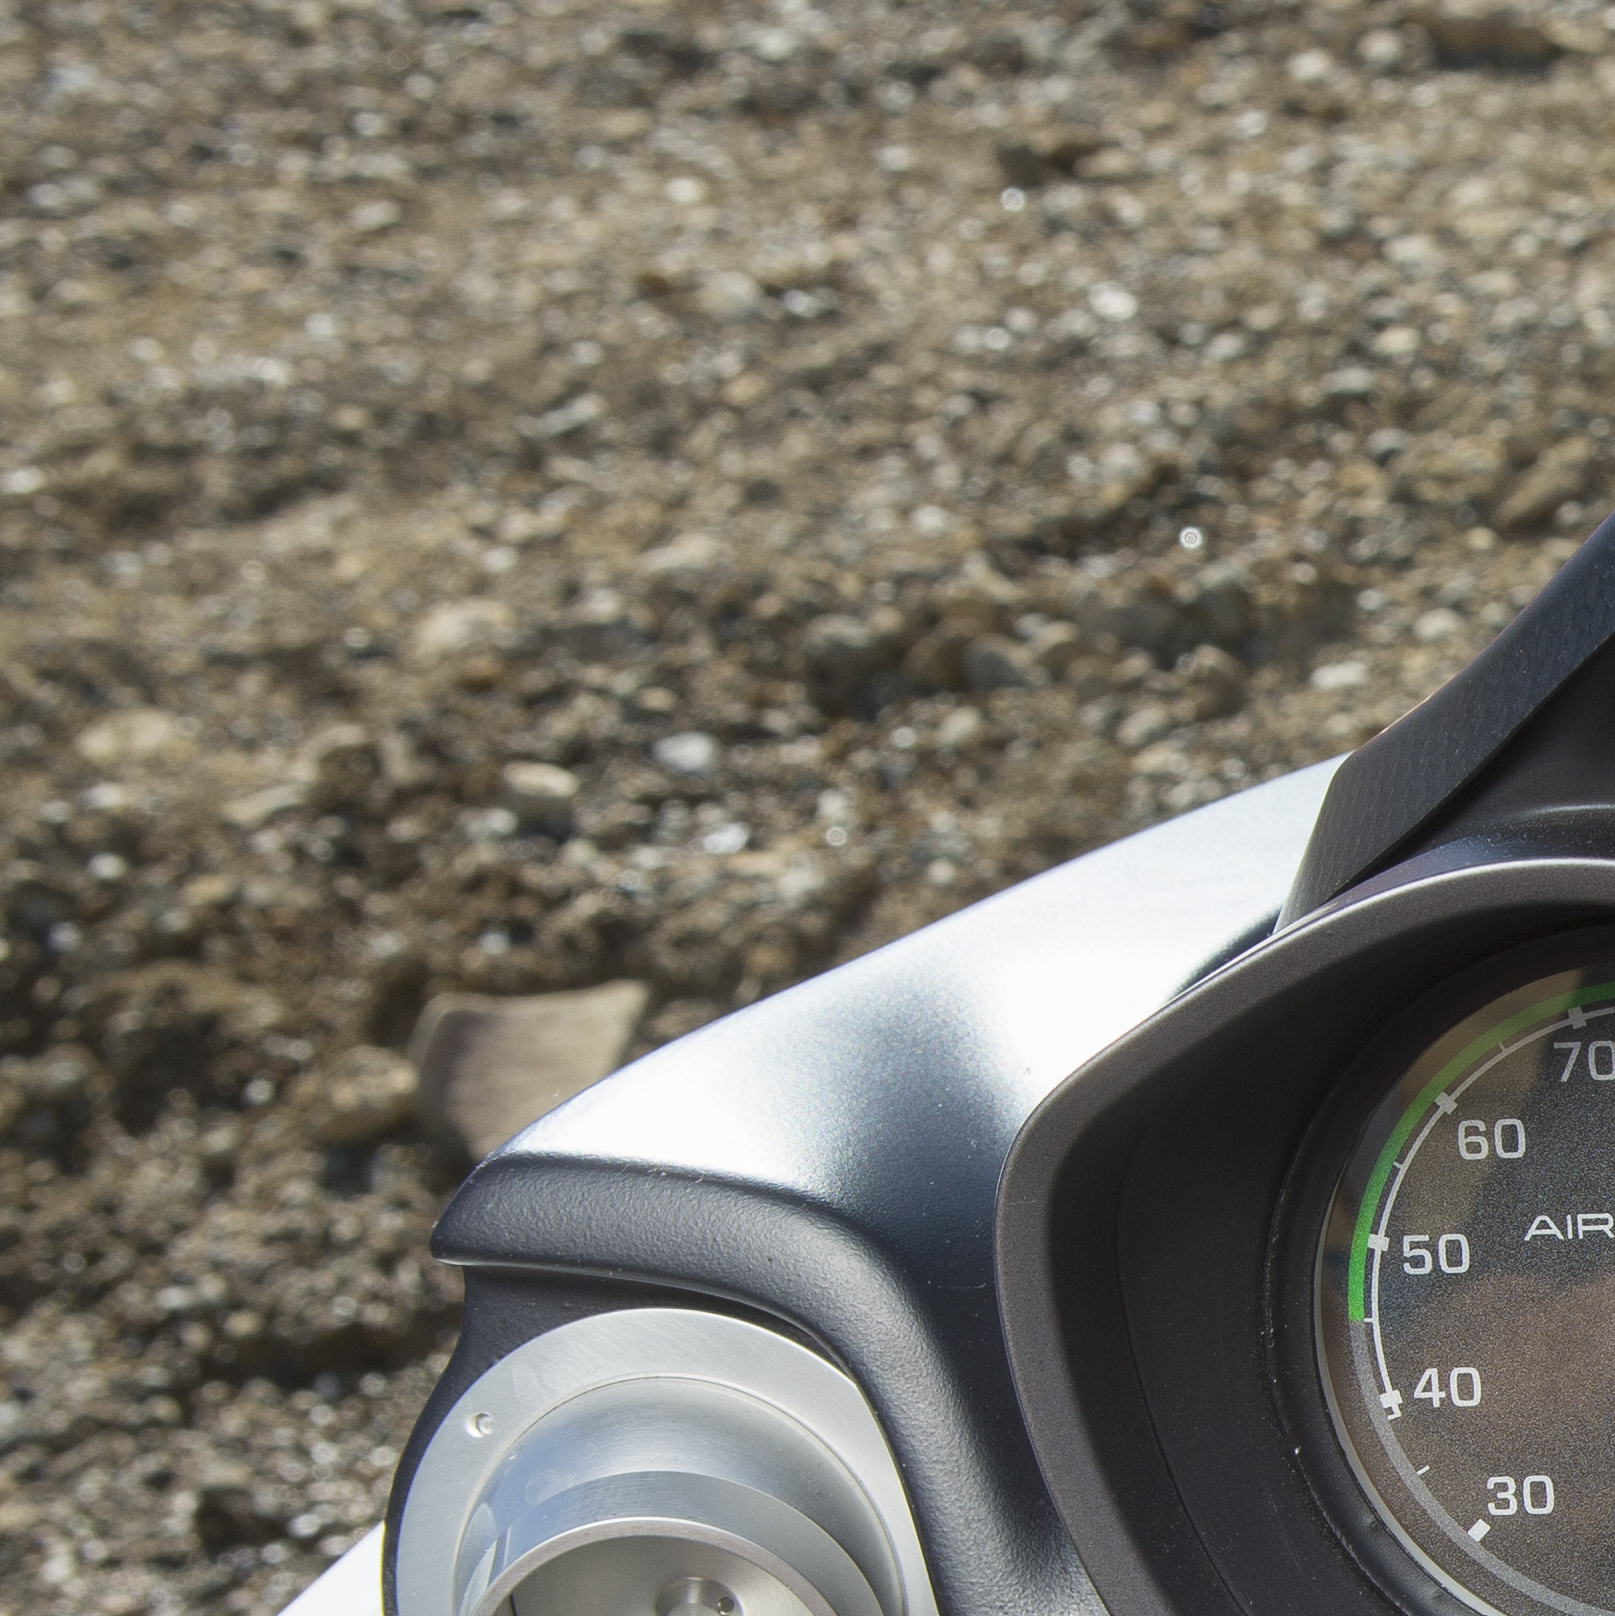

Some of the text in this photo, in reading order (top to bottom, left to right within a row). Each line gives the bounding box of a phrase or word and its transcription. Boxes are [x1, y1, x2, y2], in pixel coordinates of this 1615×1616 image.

[1457, 1118, 1526, 1160] 60
[1401, 1233, 1470, 1275] 50
[1413, 1366, 1482, 1408] 40
[1486, 1475, 1555, 1515] 30
